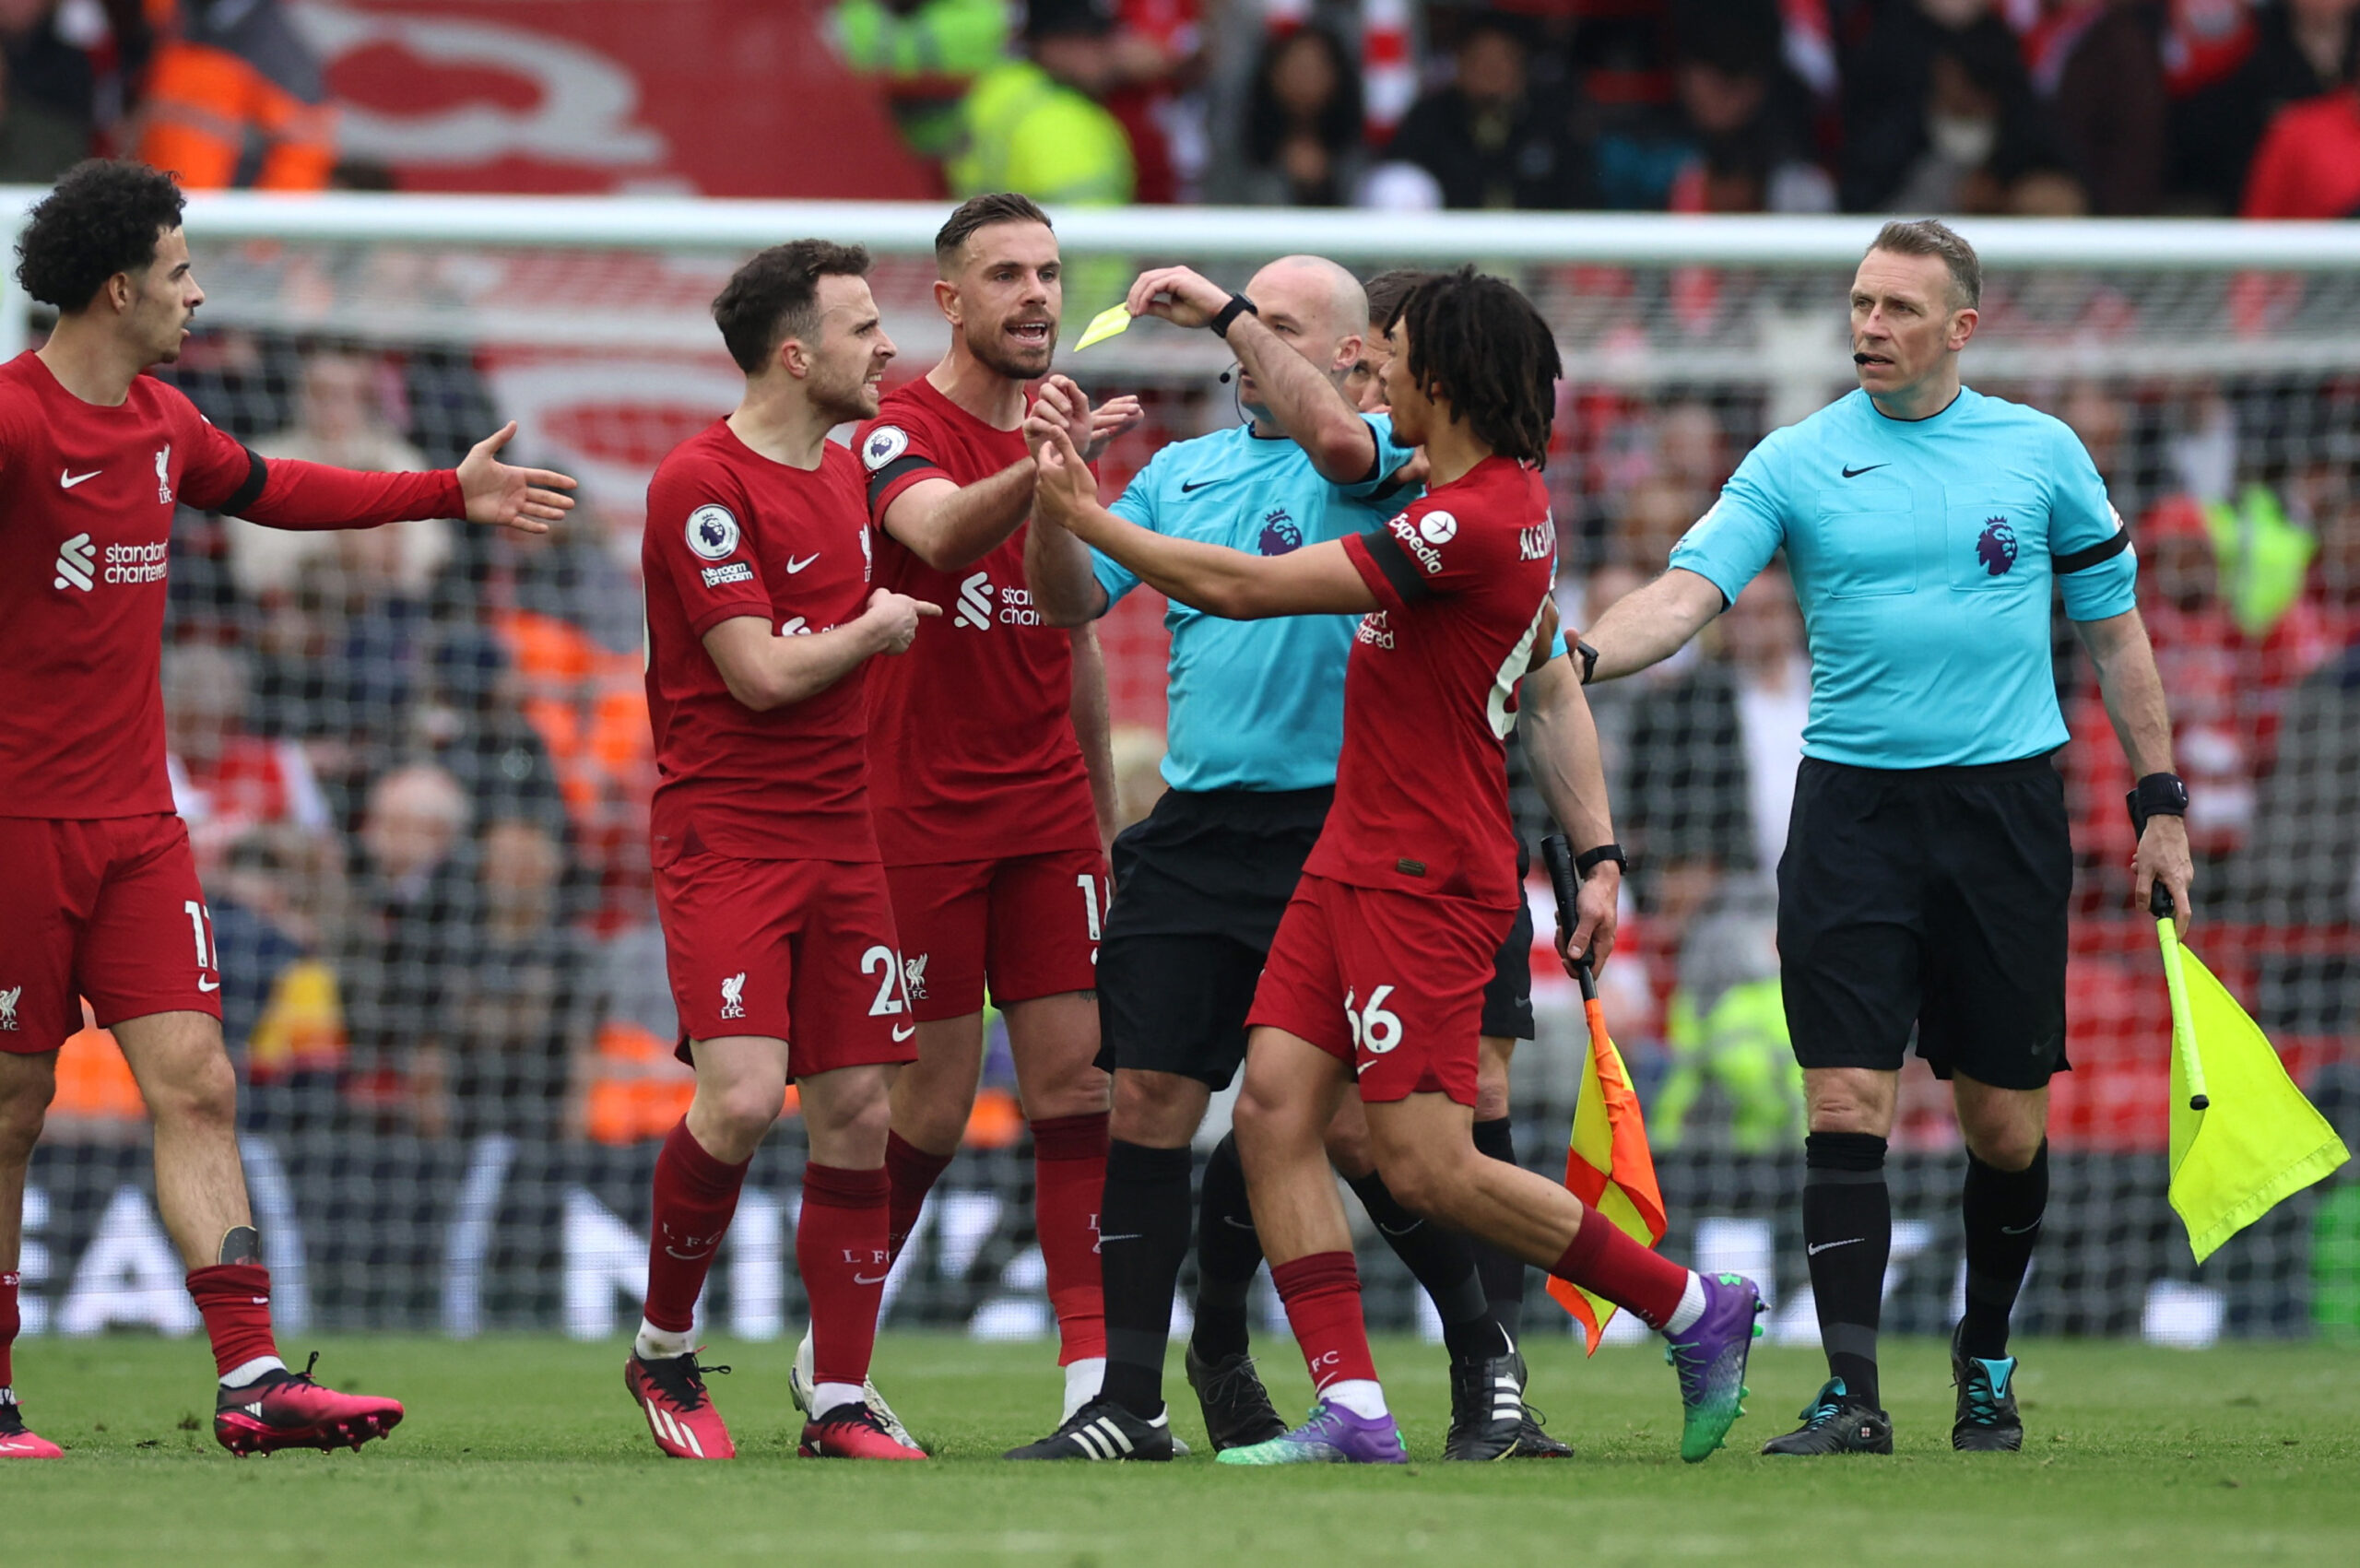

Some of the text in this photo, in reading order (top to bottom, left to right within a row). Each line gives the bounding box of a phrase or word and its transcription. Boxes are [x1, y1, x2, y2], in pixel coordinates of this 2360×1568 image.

[1389, 513, 1443, 573] Expedia
[1077, 874, 1112, 941] 1
[861, 945, 913, 1016] 2
